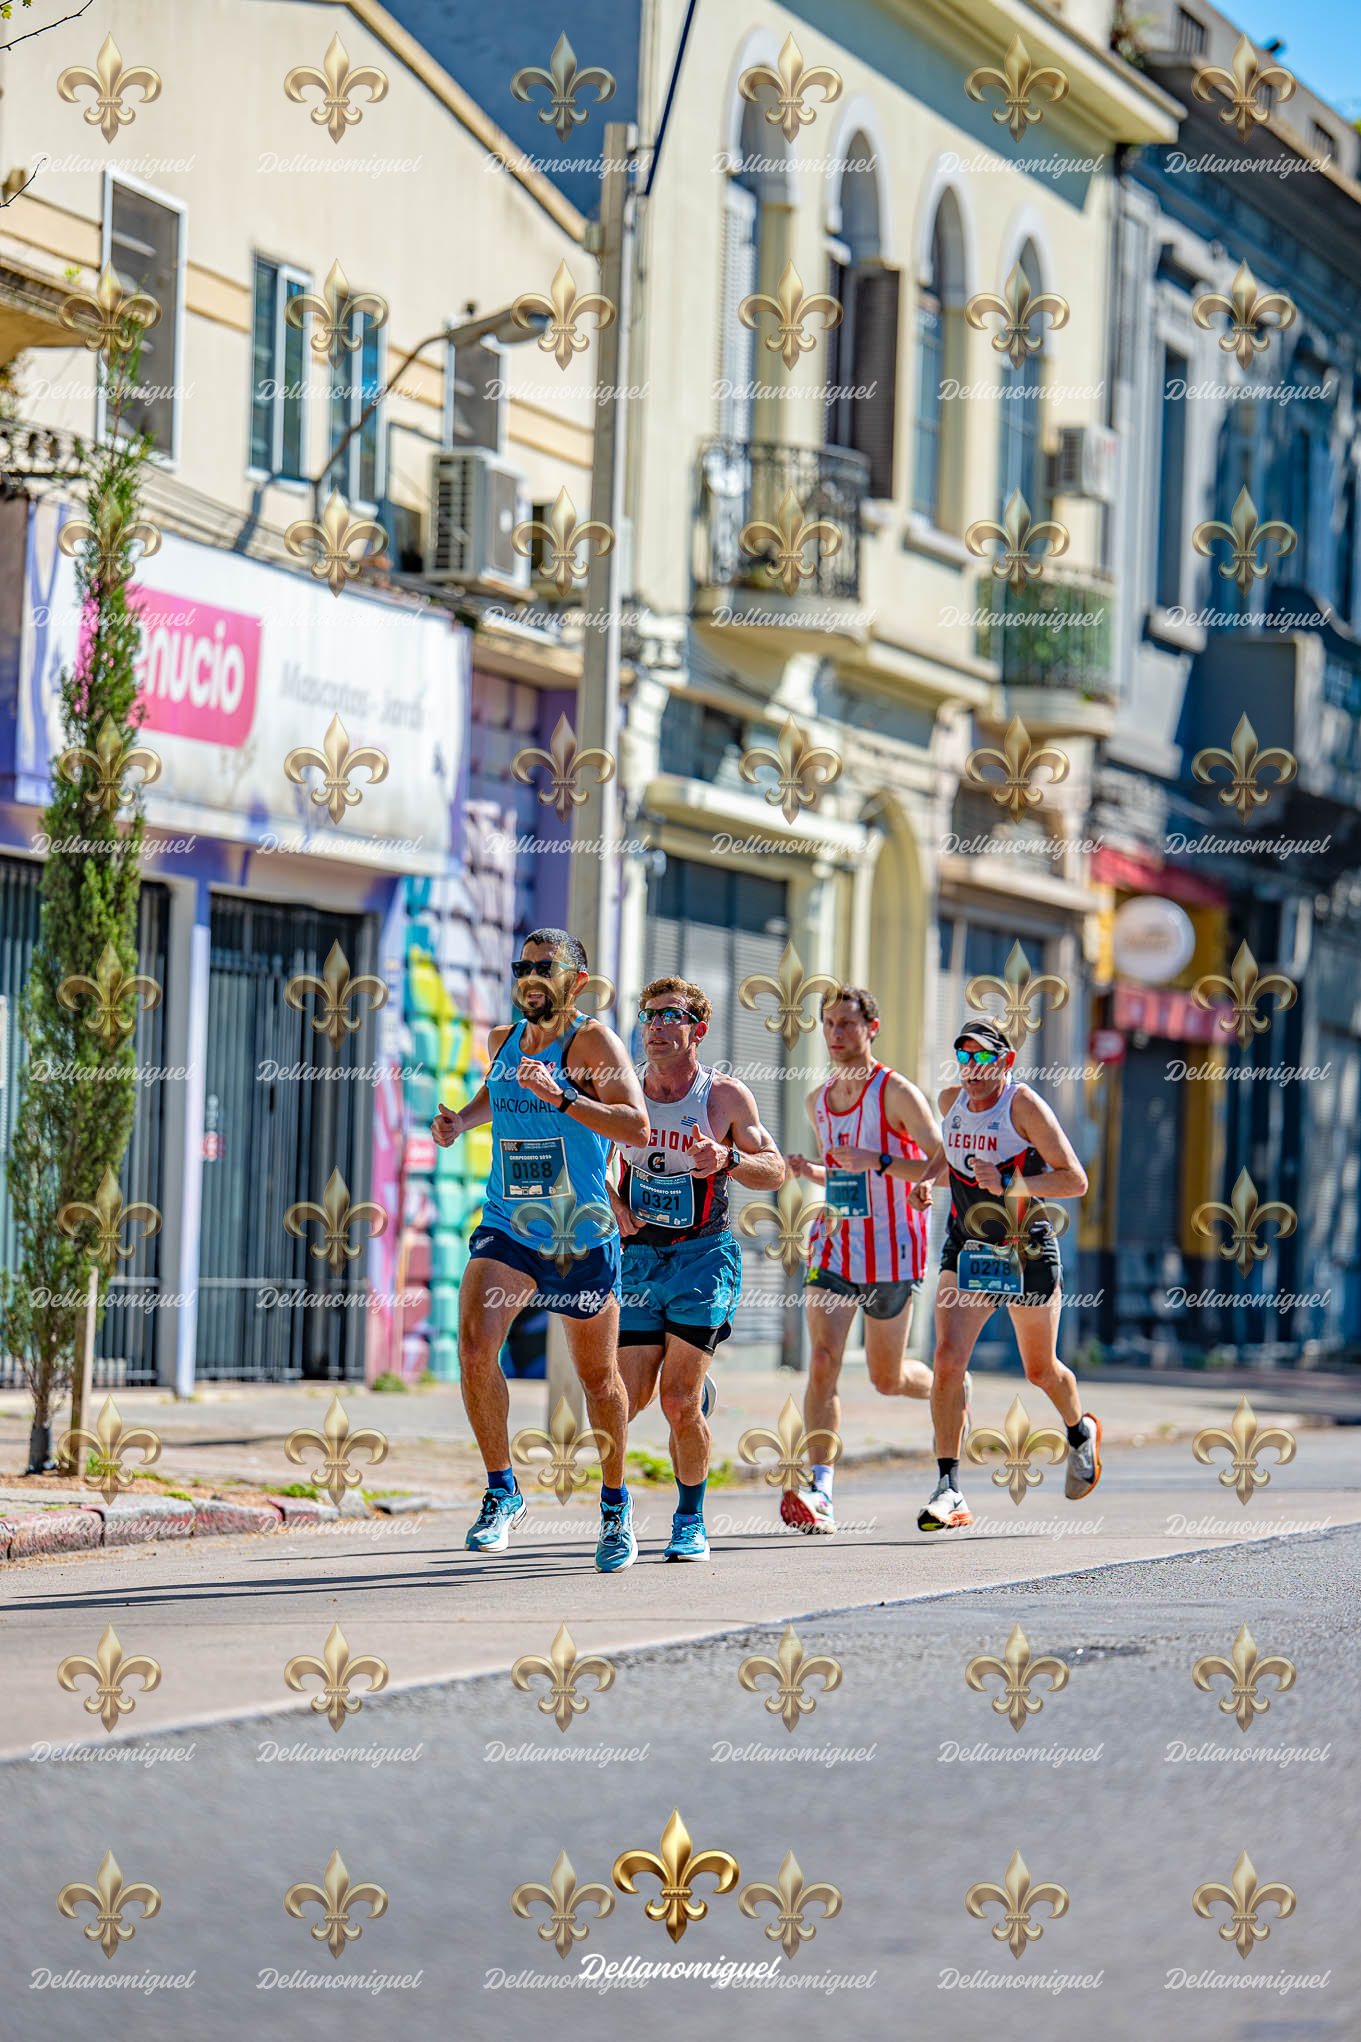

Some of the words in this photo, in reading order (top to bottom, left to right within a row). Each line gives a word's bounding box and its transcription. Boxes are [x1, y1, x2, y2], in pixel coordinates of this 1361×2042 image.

[131, 616, 245, 714] enucio
[493, 1098, 557, 1114] NACIONAL
[647, 1129, 694, 1152] GION
[948, 1133, 998, 1152] LEGION
[512, 1161, 553, 1179] 0188
[642, 1190, 680, 1211] 0321
[970, 1260, 1011, 1276] 0278
